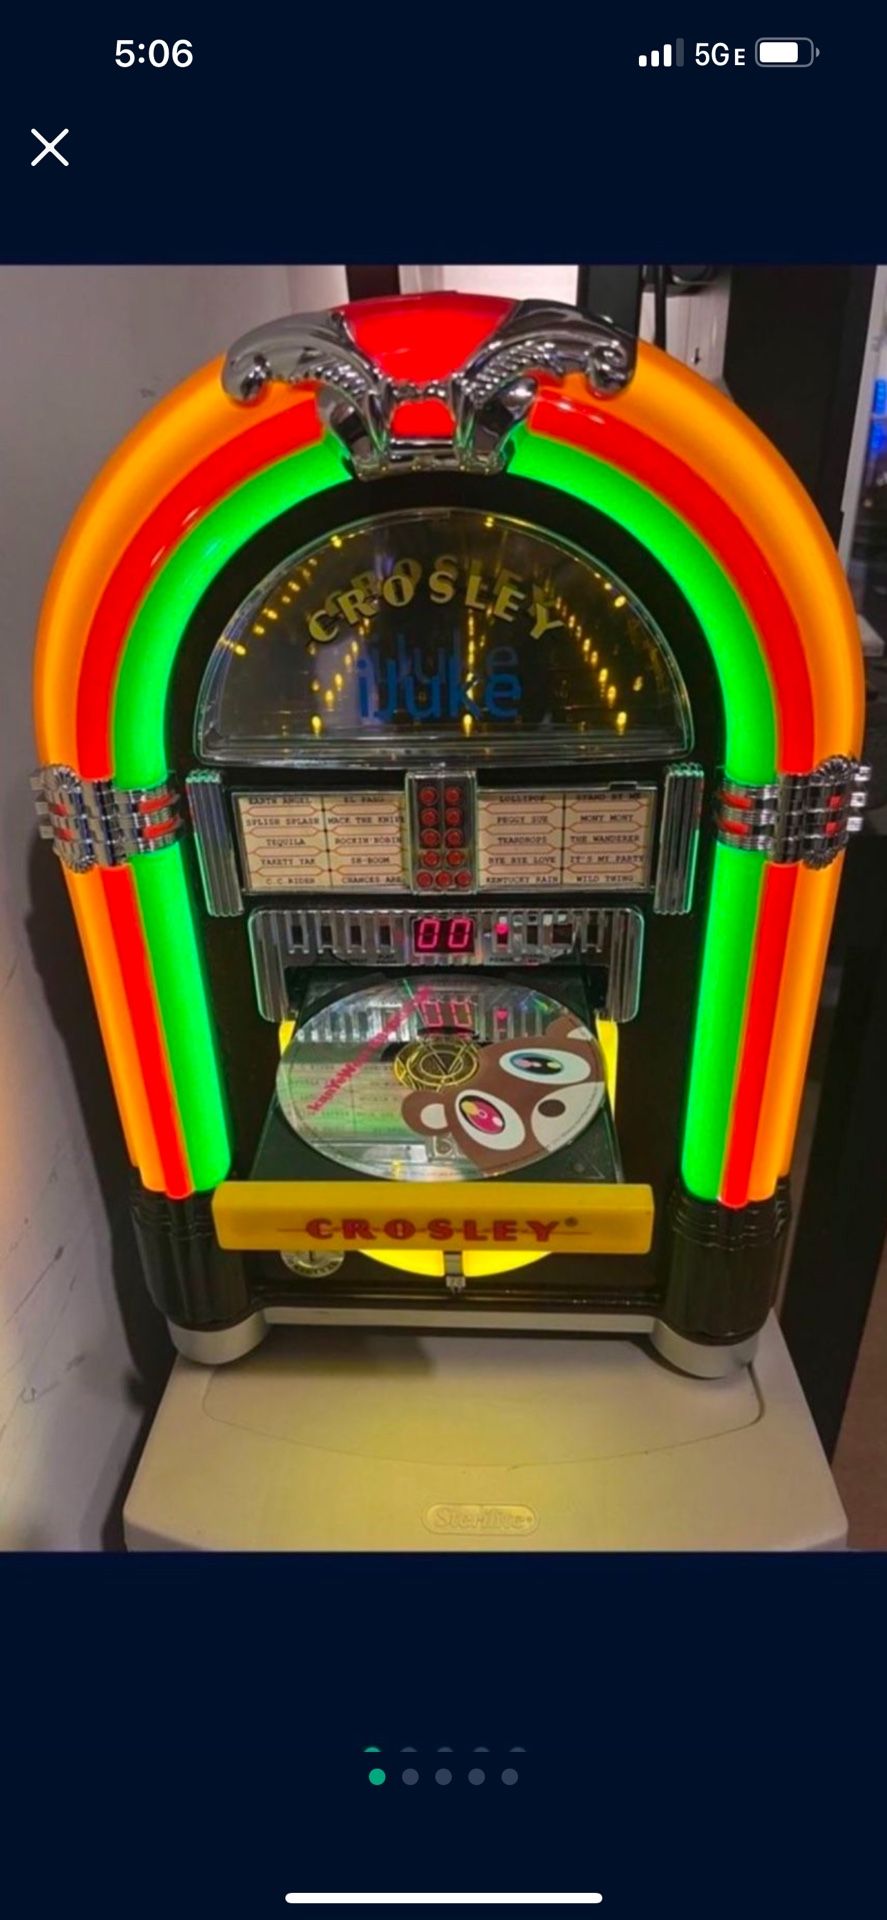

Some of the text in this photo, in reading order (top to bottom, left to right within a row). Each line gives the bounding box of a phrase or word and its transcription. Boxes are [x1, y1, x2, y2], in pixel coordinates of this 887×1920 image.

[307, 570, 564, 643] CROSLEY
[355, 656, 523, 721] iJuke
[246, 818, 320, 826] SPLISH SPLASH
[355, 816, 372, 824] THE
[378, 816, 405, 824] KNIFE
[497, 816, 526, 824] PEGGY
[266, 839, 306, 847] TEQUILA
[570, 835, 640, 843] THE WANDERER
[488, 856, 557, 864] BYE BYE LOVE
[570, 855, 645, 863] IT'S MY PARTY
[342, 876, 380, 884] CHANCES
[486, 876, 530, 884] KENTUCKY
[304, 1217, 561, 1243] CROSLEY
